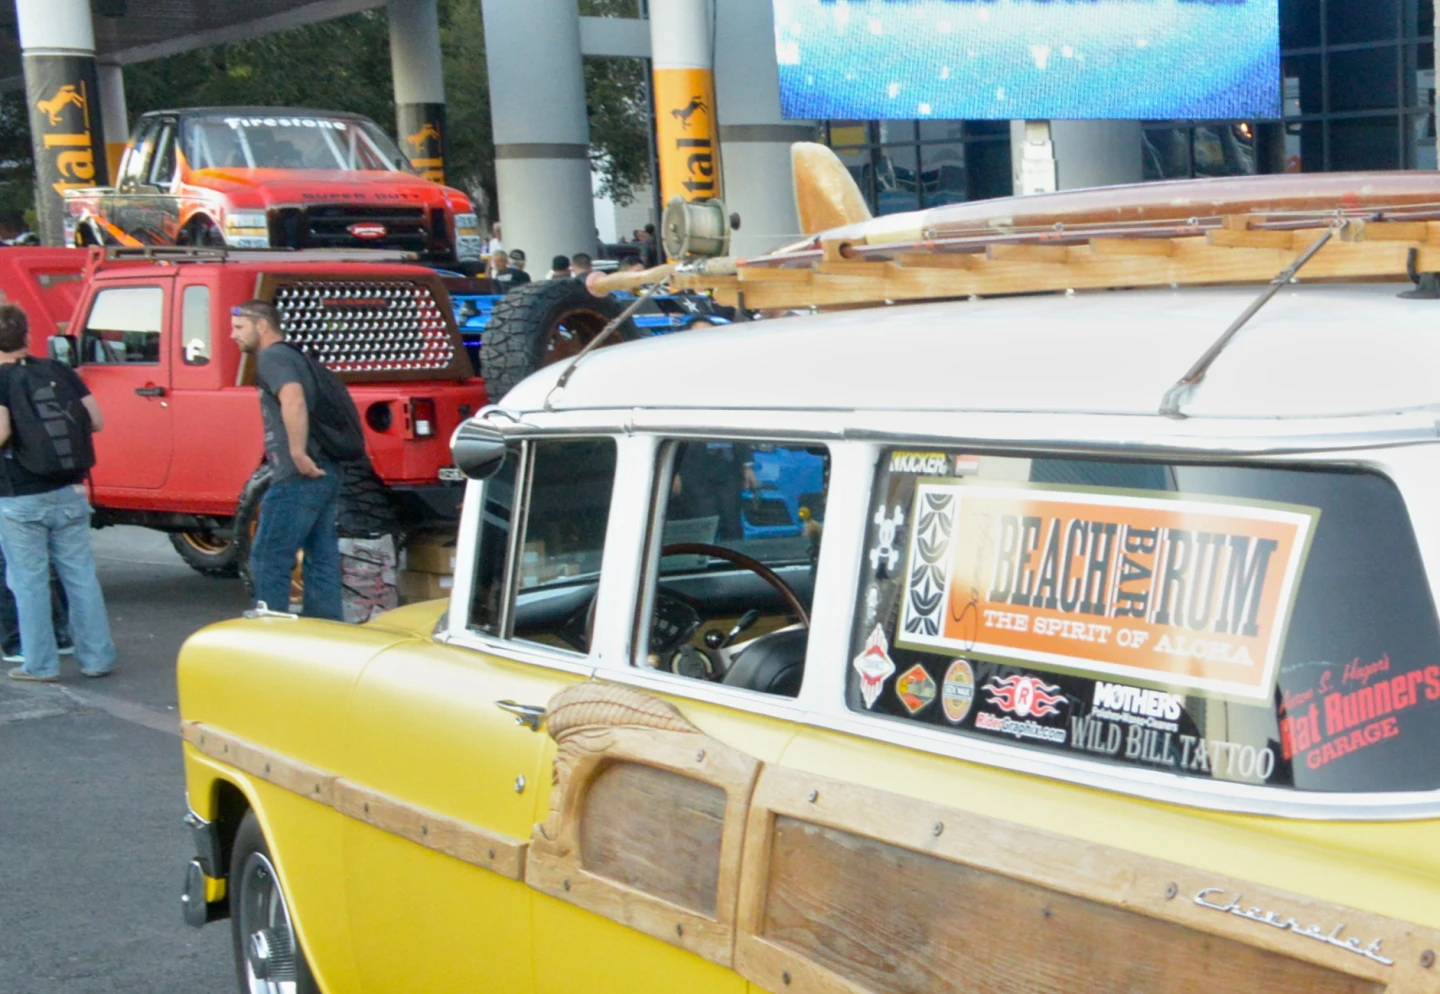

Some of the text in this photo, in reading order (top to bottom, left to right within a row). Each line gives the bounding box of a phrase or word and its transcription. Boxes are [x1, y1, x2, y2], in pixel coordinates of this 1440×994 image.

[225, 117, 347, 131] Firestone
[375, 192, 421, 200] DUTY
[987, 515, 1279, 638] BEACH BAR RUM
[983, 609, 1256, 668] THE SPIRIT OF ALOHA
[1018, 687, 1029, 704] R
[1092, 680, 1185, 722] MOTHERS
[1070, 714, 1276, 781] WILD BILL TATTOO
[1280, 703, 1322, 761] Rat
[1306, 716, 1400, 770] GARAGE
[1193, 886, 1395, 967] Chevrolet
